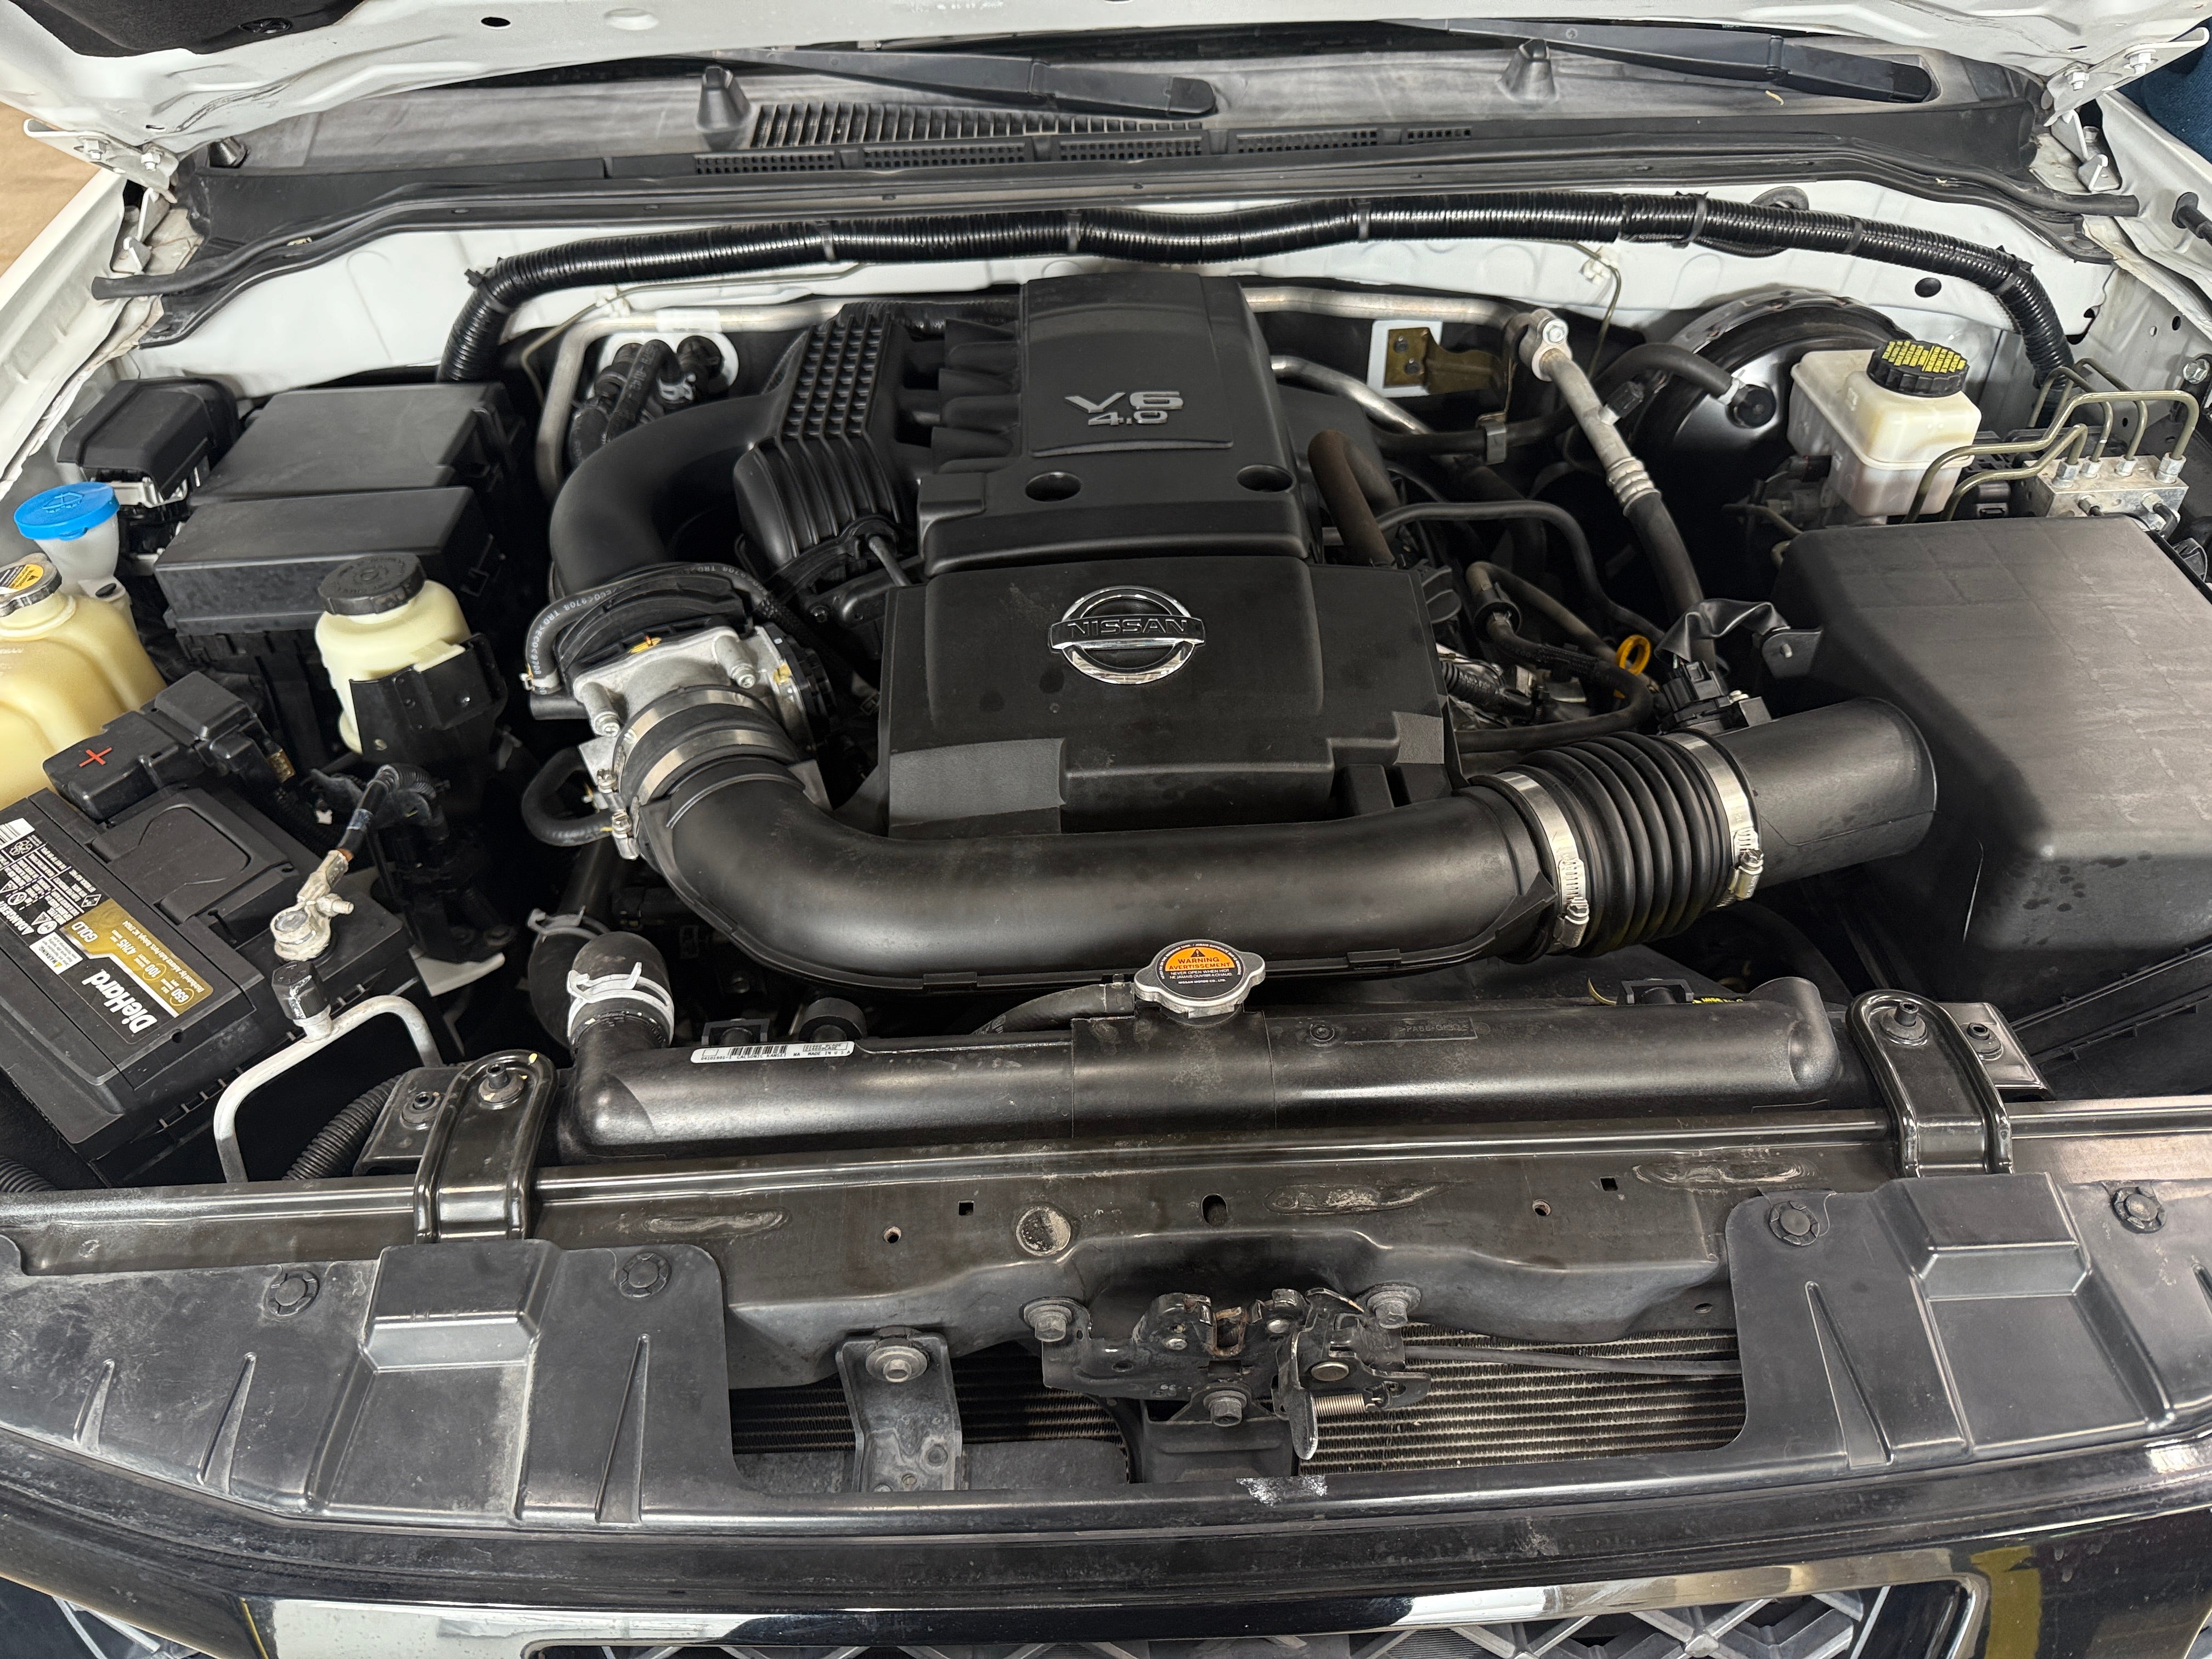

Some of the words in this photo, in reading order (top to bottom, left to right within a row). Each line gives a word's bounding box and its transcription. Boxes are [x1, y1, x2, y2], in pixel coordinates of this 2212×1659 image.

[1064, 391, 1183, 413] V6
[1087, 410, 1167, 426] 4.0
[1066, 619, 1188, 640] NISSAN
[70, 920, 98, 943] GOLD
[116, 939, 138, 956] 47H5
[144, 963, 162, 977] 100
[81, 969, 158, 1034] DieHard
[170, 988, 190, 1003] 650
